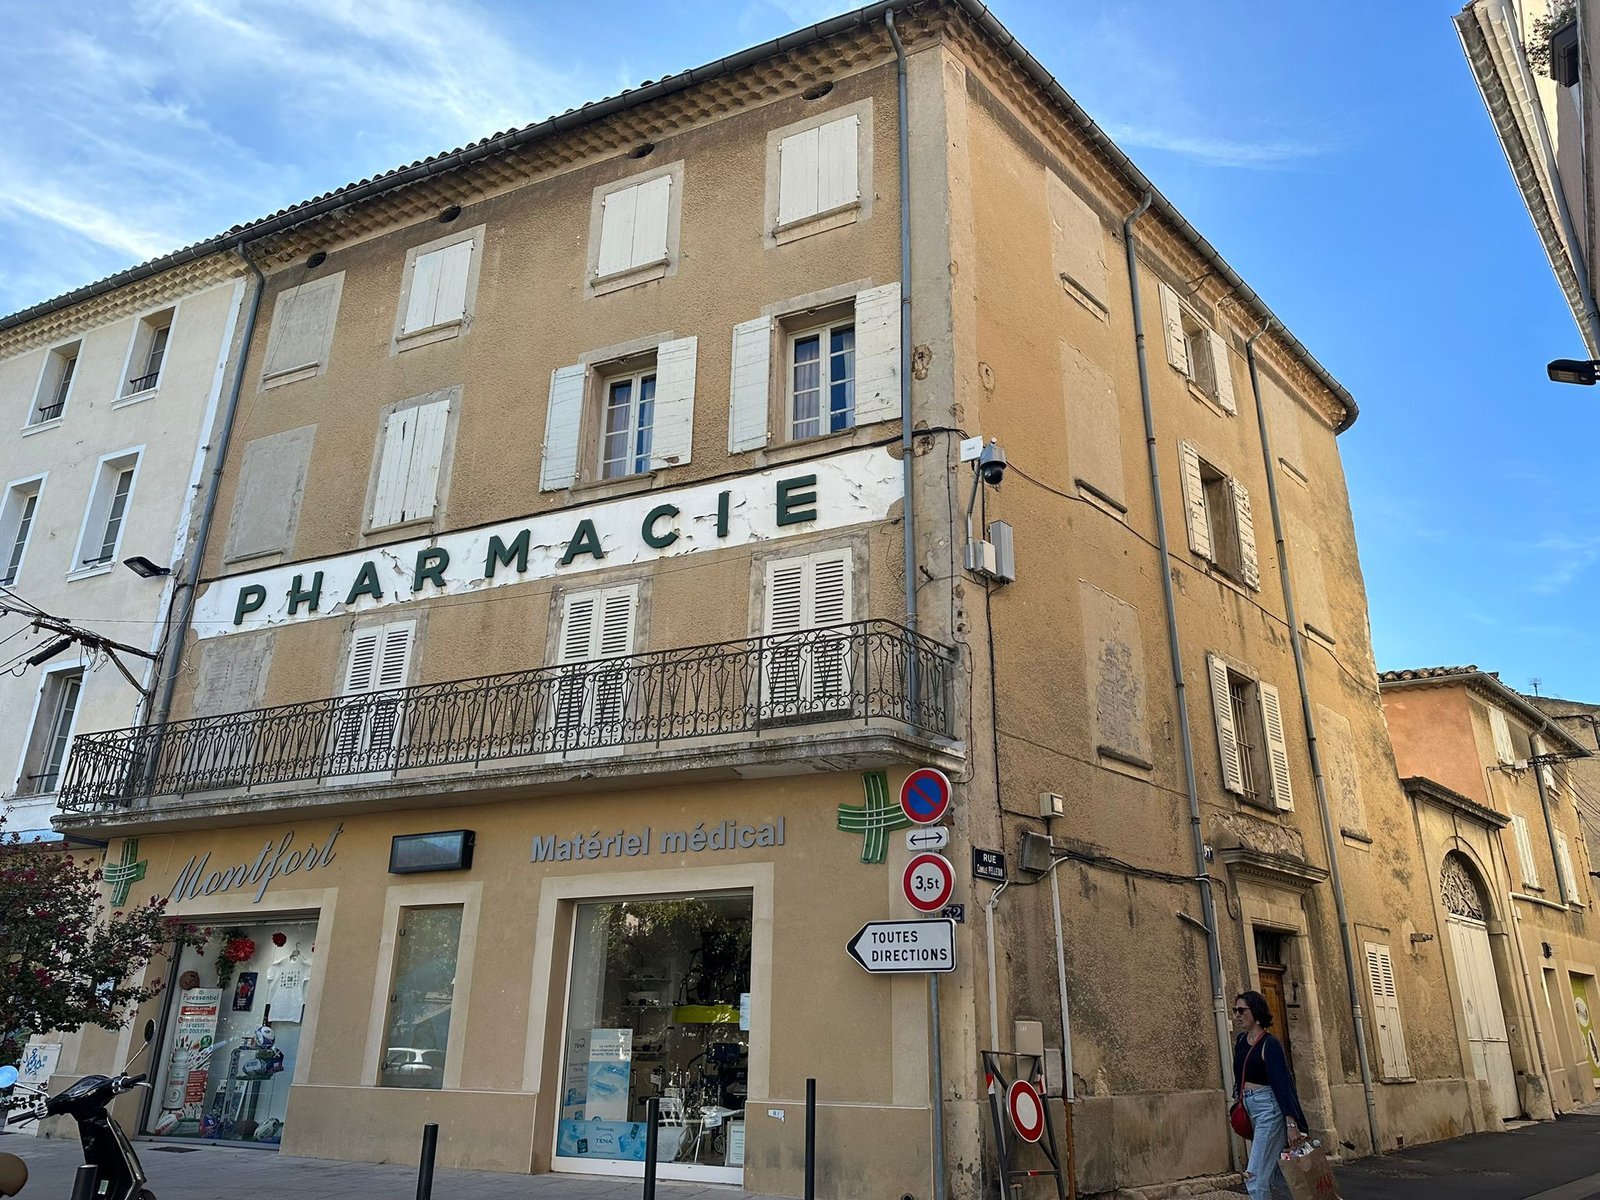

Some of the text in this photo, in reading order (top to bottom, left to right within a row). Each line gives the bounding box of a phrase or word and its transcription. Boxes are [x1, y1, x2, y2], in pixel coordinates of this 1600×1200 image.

[233, 473, 817, 626] PHARMACIE
[530, 815, 786, 863] Matériel médical
[165, 821, 344, 904] Montfort
[982, 852, 997, 865] RUE
[943, 906, 961, 921] 32
[871, 930, 919, 944] TOUTES
[871, 948, 948, 962] DIRECTIONS
